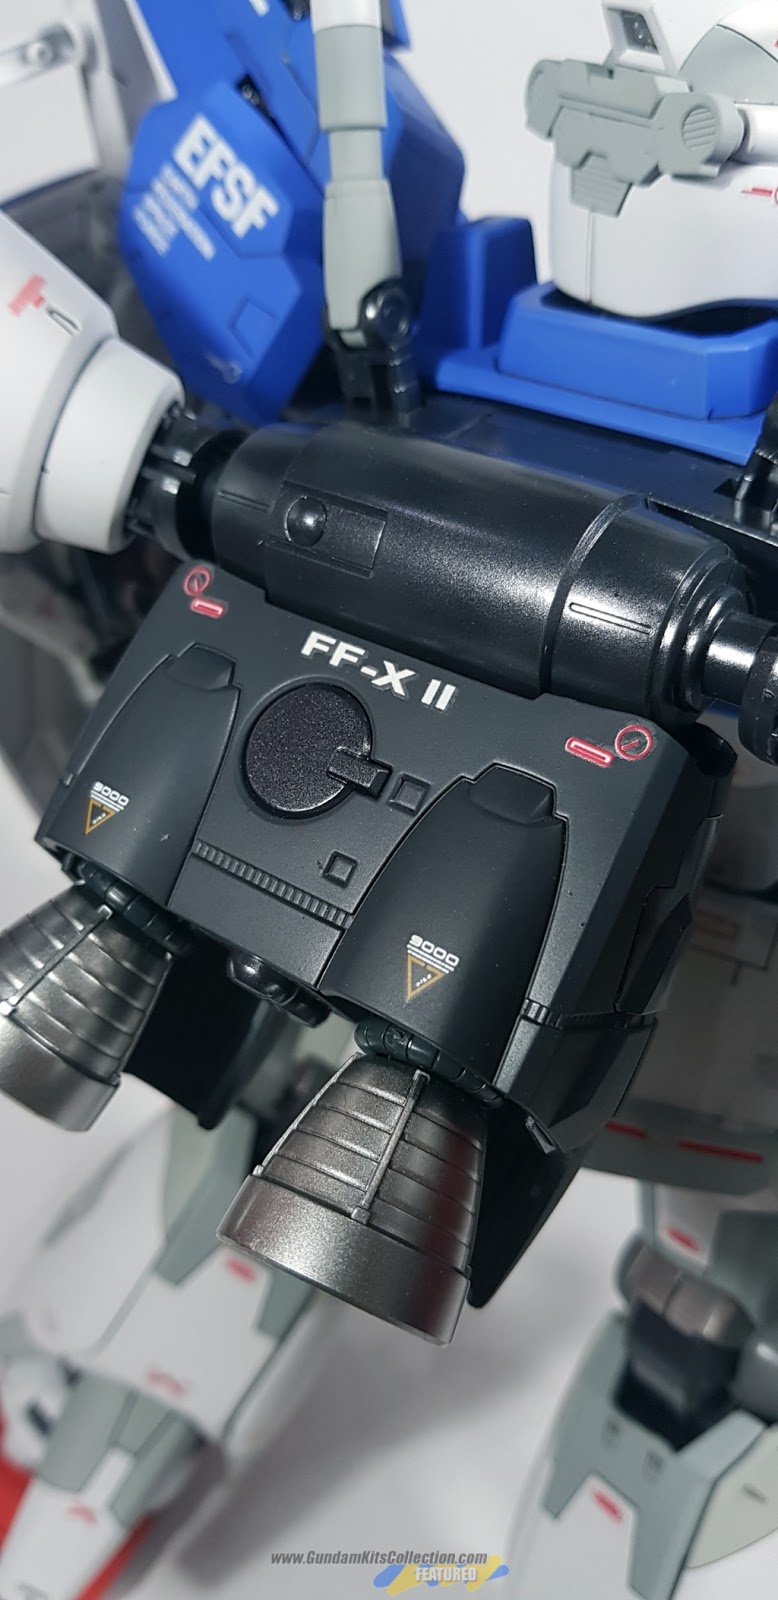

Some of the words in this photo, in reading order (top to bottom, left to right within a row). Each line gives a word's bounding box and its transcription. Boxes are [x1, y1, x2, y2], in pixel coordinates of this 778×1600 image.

[173, 114, 279, 239] EFSF
[301, 631, 416, 697] FF-X
[93, 781, 130, 807] 9000
[409, 934, 460, 967] 9000
